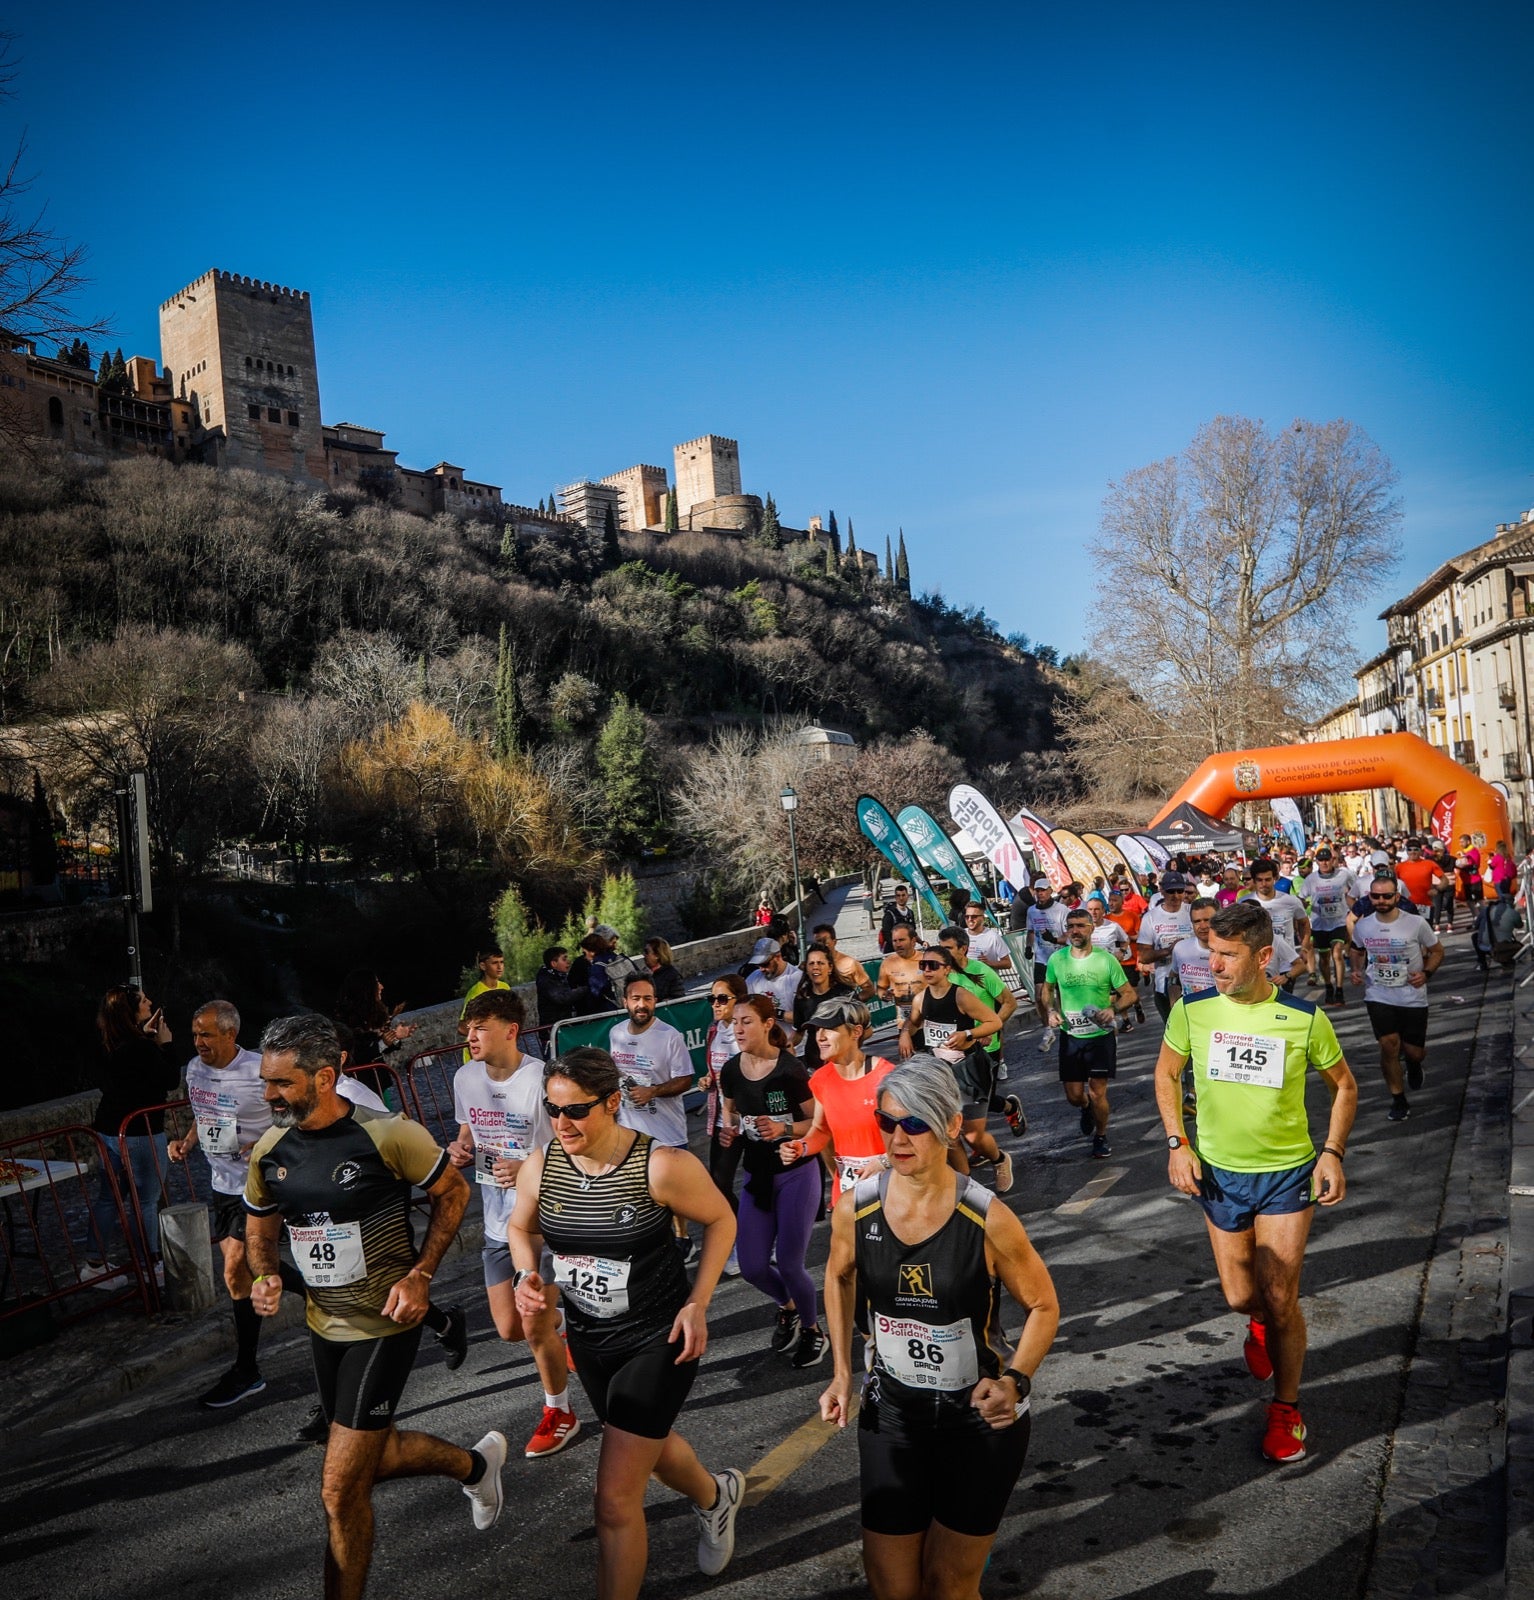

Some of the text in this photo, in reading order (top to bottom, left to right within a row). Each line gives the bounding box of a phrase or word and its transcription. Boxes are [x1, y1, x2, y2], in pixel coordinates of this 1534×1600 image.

[1322, 770, 1334, 778] de
[1336, 765, 1376, 777] Deportes
[1181, 963, 1209, 974] 9 Carrera
[1378, 969, 1400, 978] 536
[929, 1028, 950, 1039] 500
[1214, 1032, 1253, 1043] 9 Carrera
[1222, 1040, 1254, 1048] Solidaria
[1226, 1046, 1268, 1065] 145
[1229, 1062, 1243, 1070] JOSE
[767, 1091, 785, 1103] BOX
[768, 1102, 788, 1112] FIVE
[469, 1107, 505, 1124] 9 Carrera
[207, 1126, 222, 1138] 47
[477, 1143, 484, 1153] 9
[290, 1228, 324, 1241] 9 Carrera
[309, 1243, 336, 1262] 48
[568, 1268, 609, 1296] 125
[586, 1293, 598, 1302] DEL
[879, 1317, 929, 1334] 9 Carrera
[890, 1328, 932, 1342] Solidaria
[908, 1338, 945, 1365] 86
[914, 1360, 941, 1372] GRACIA
